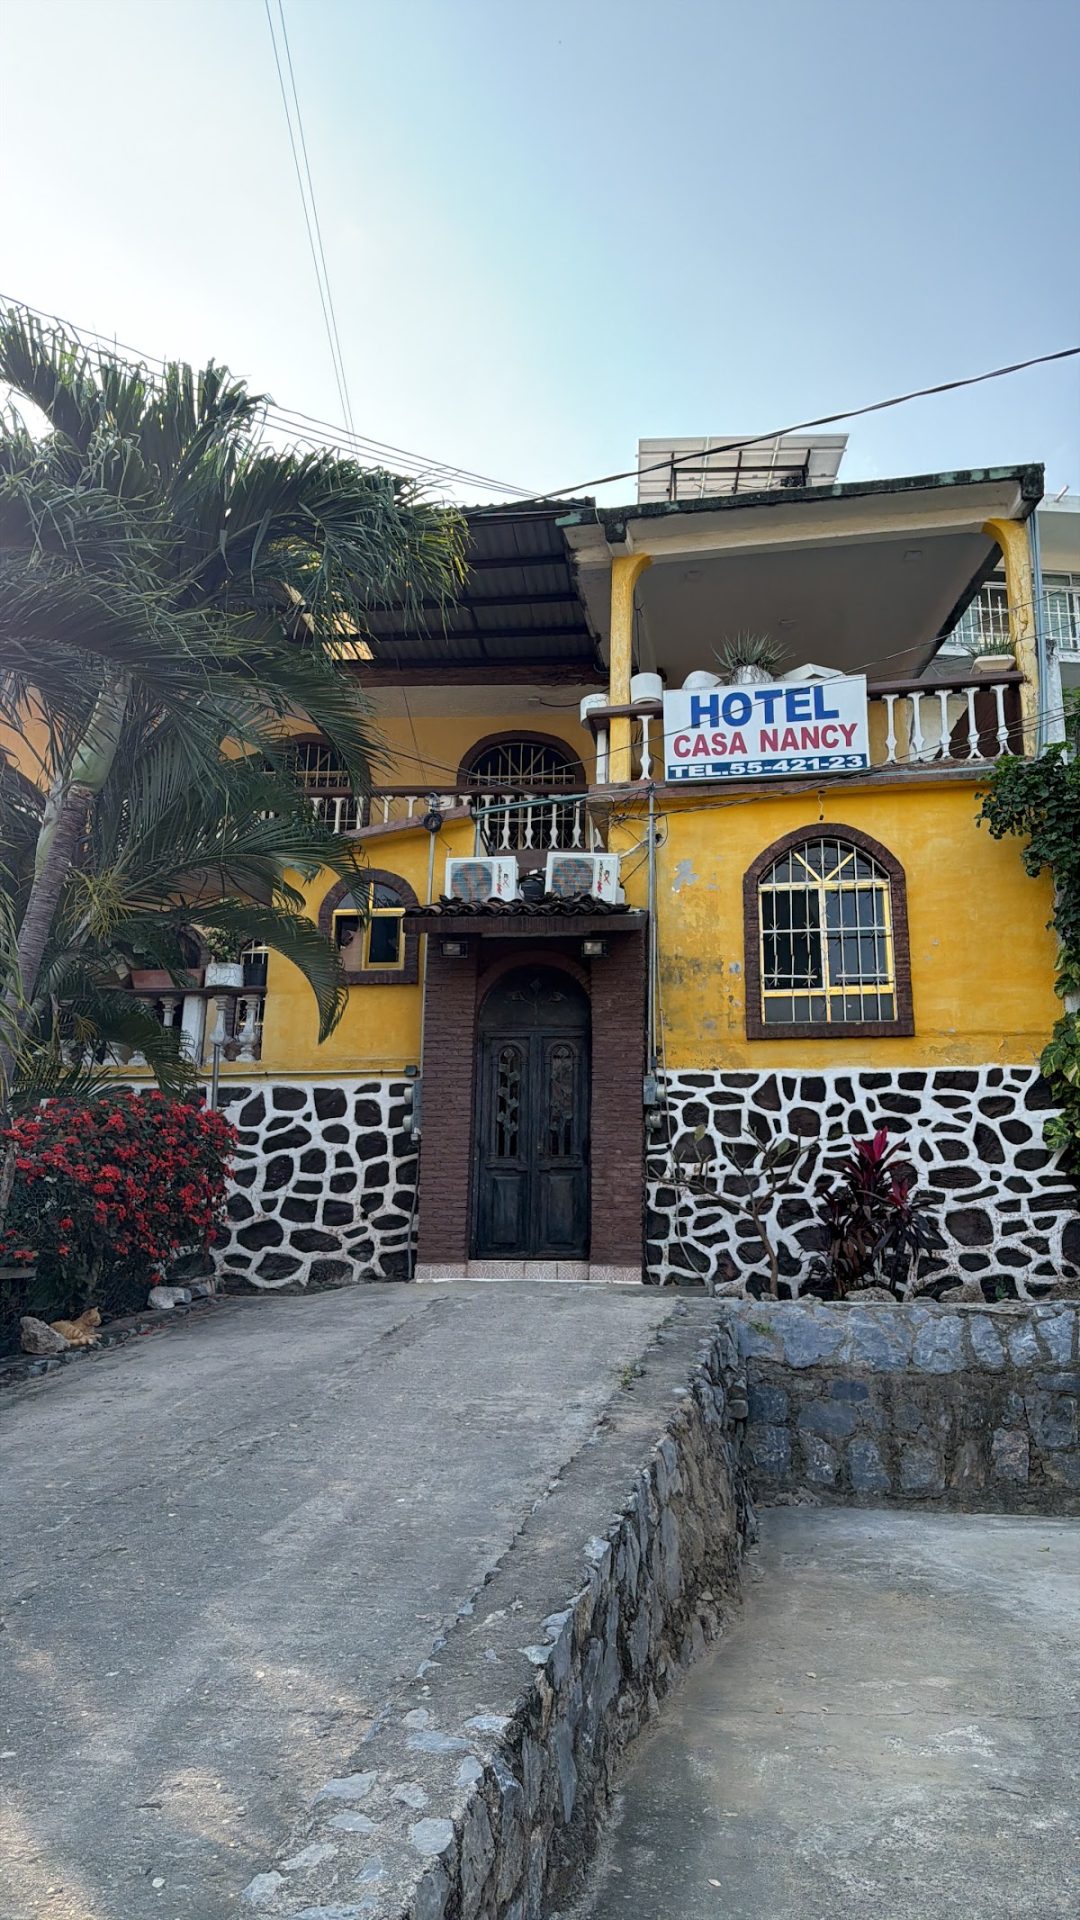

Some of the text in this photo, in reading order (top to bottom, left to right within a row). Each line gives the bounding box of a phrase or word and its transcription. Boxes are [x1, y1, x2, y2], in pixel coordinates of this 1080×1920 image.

[690, 685, 839, 729] HOTEL
[673, 723, 858, 758] CASA NANCY
